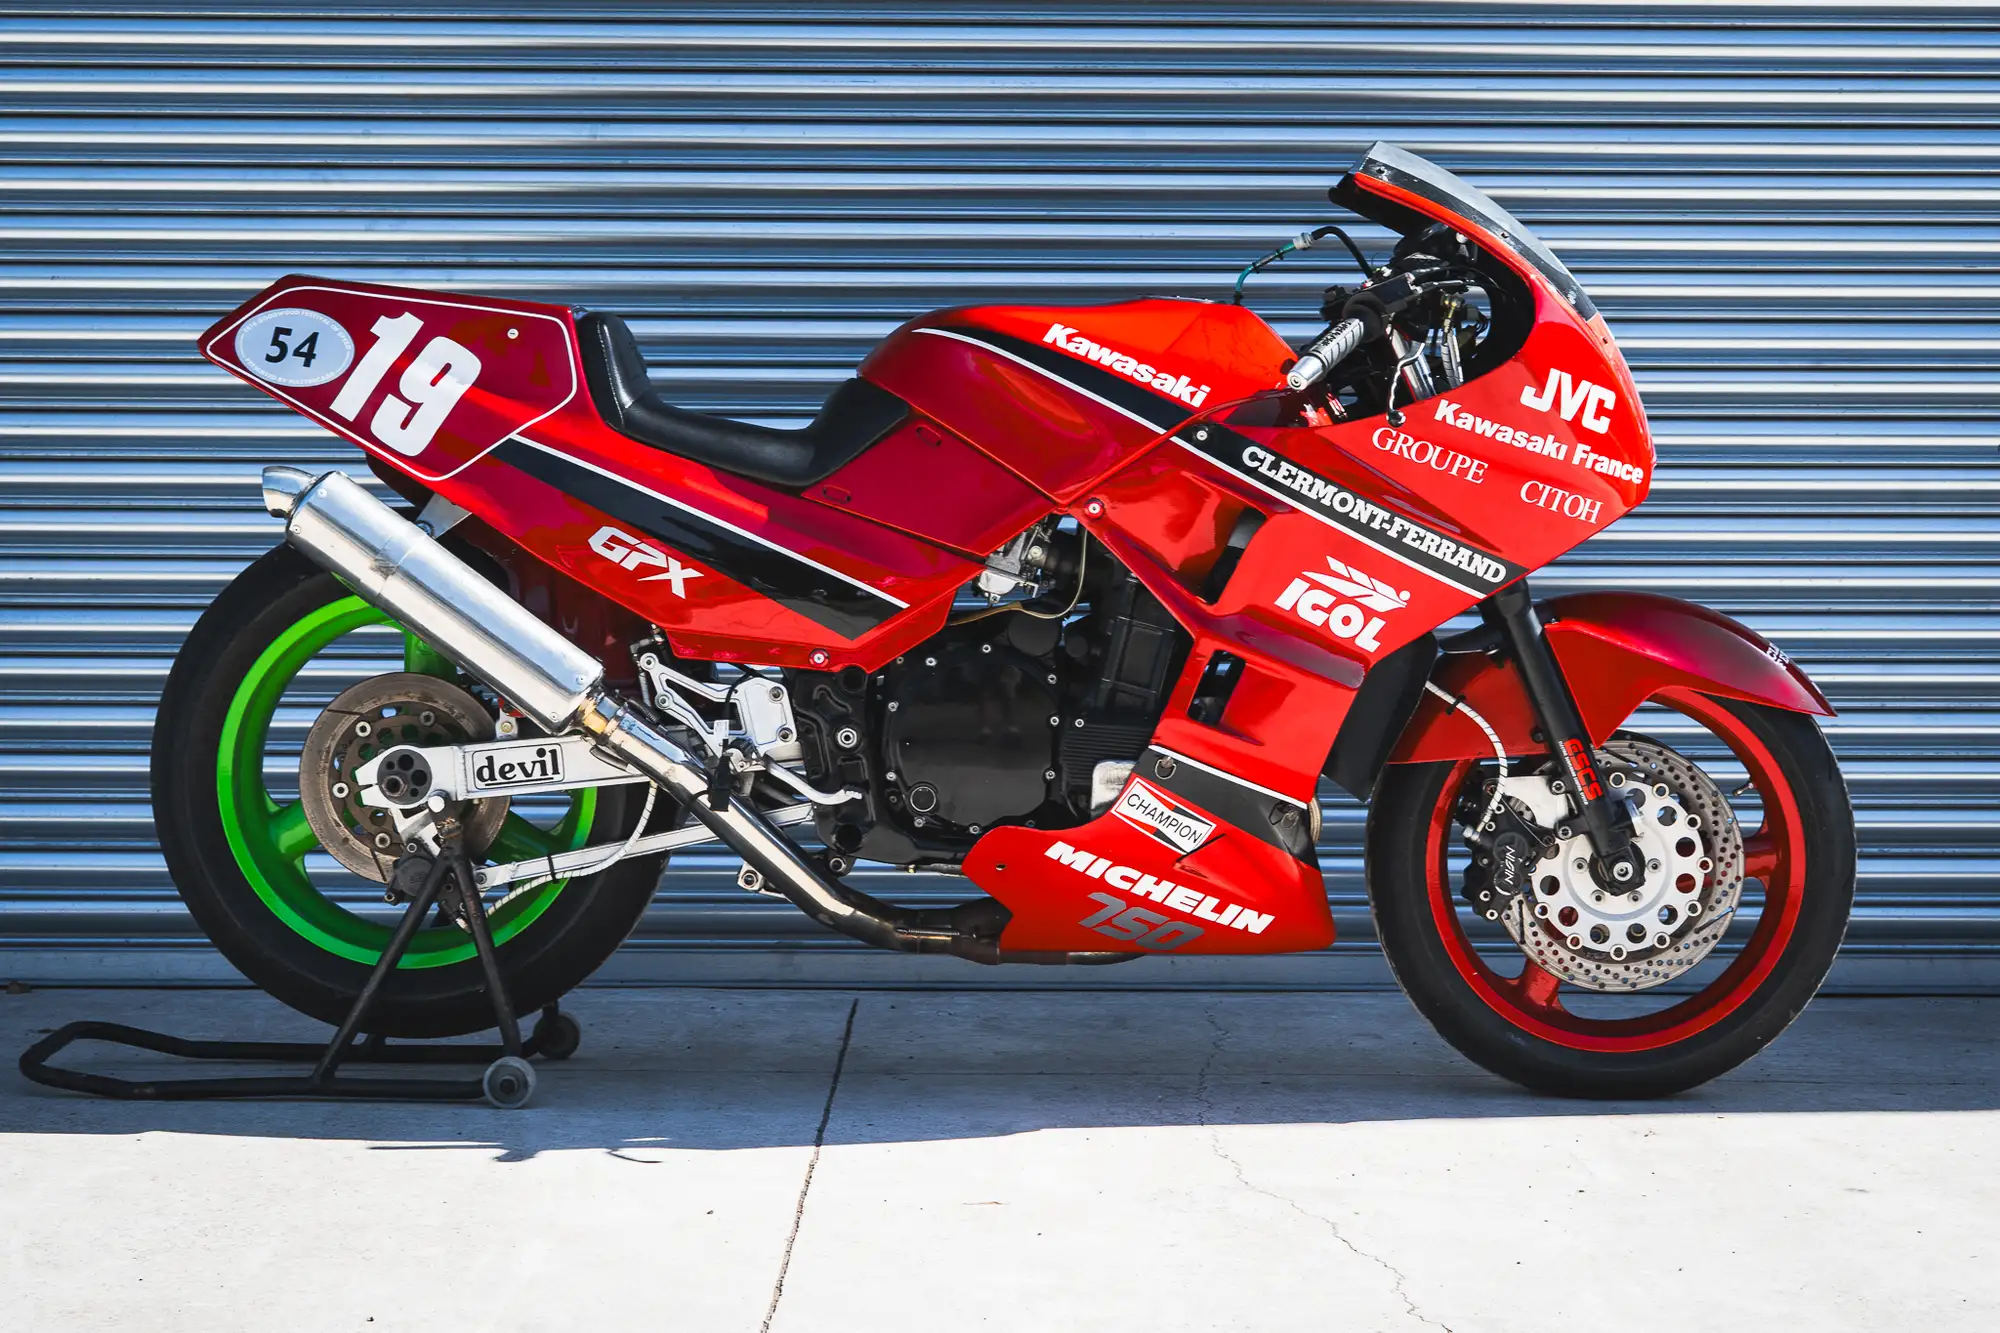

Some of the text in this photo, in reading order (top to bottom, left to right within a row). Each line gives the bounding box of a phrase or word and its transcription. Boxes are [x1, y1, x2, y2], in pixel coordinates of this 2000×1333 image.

[265, 326, 320, 368] 54
[1042, 323, 1212, 408] Kawasaki
[329, 311, 482, 457] 19
[1520, 367, 1616, 435] JVC
[1371, 426, 1489, 485] GROUPE
[1434, 399, 1644, 485] Kawasaki France
[1242, 445, 1507, 584] CLERMONT-FERRAND
[1519, 479, 1604, 524] CITOH
[588, 525, 705, 600] GPX
[475, 747, 561, 783] devil
[1127, 793, 1203, 844] CHAMPION
[1044, 840, 1276, 935] MICHELIN
[1077, 891, 1206, 951] 750
